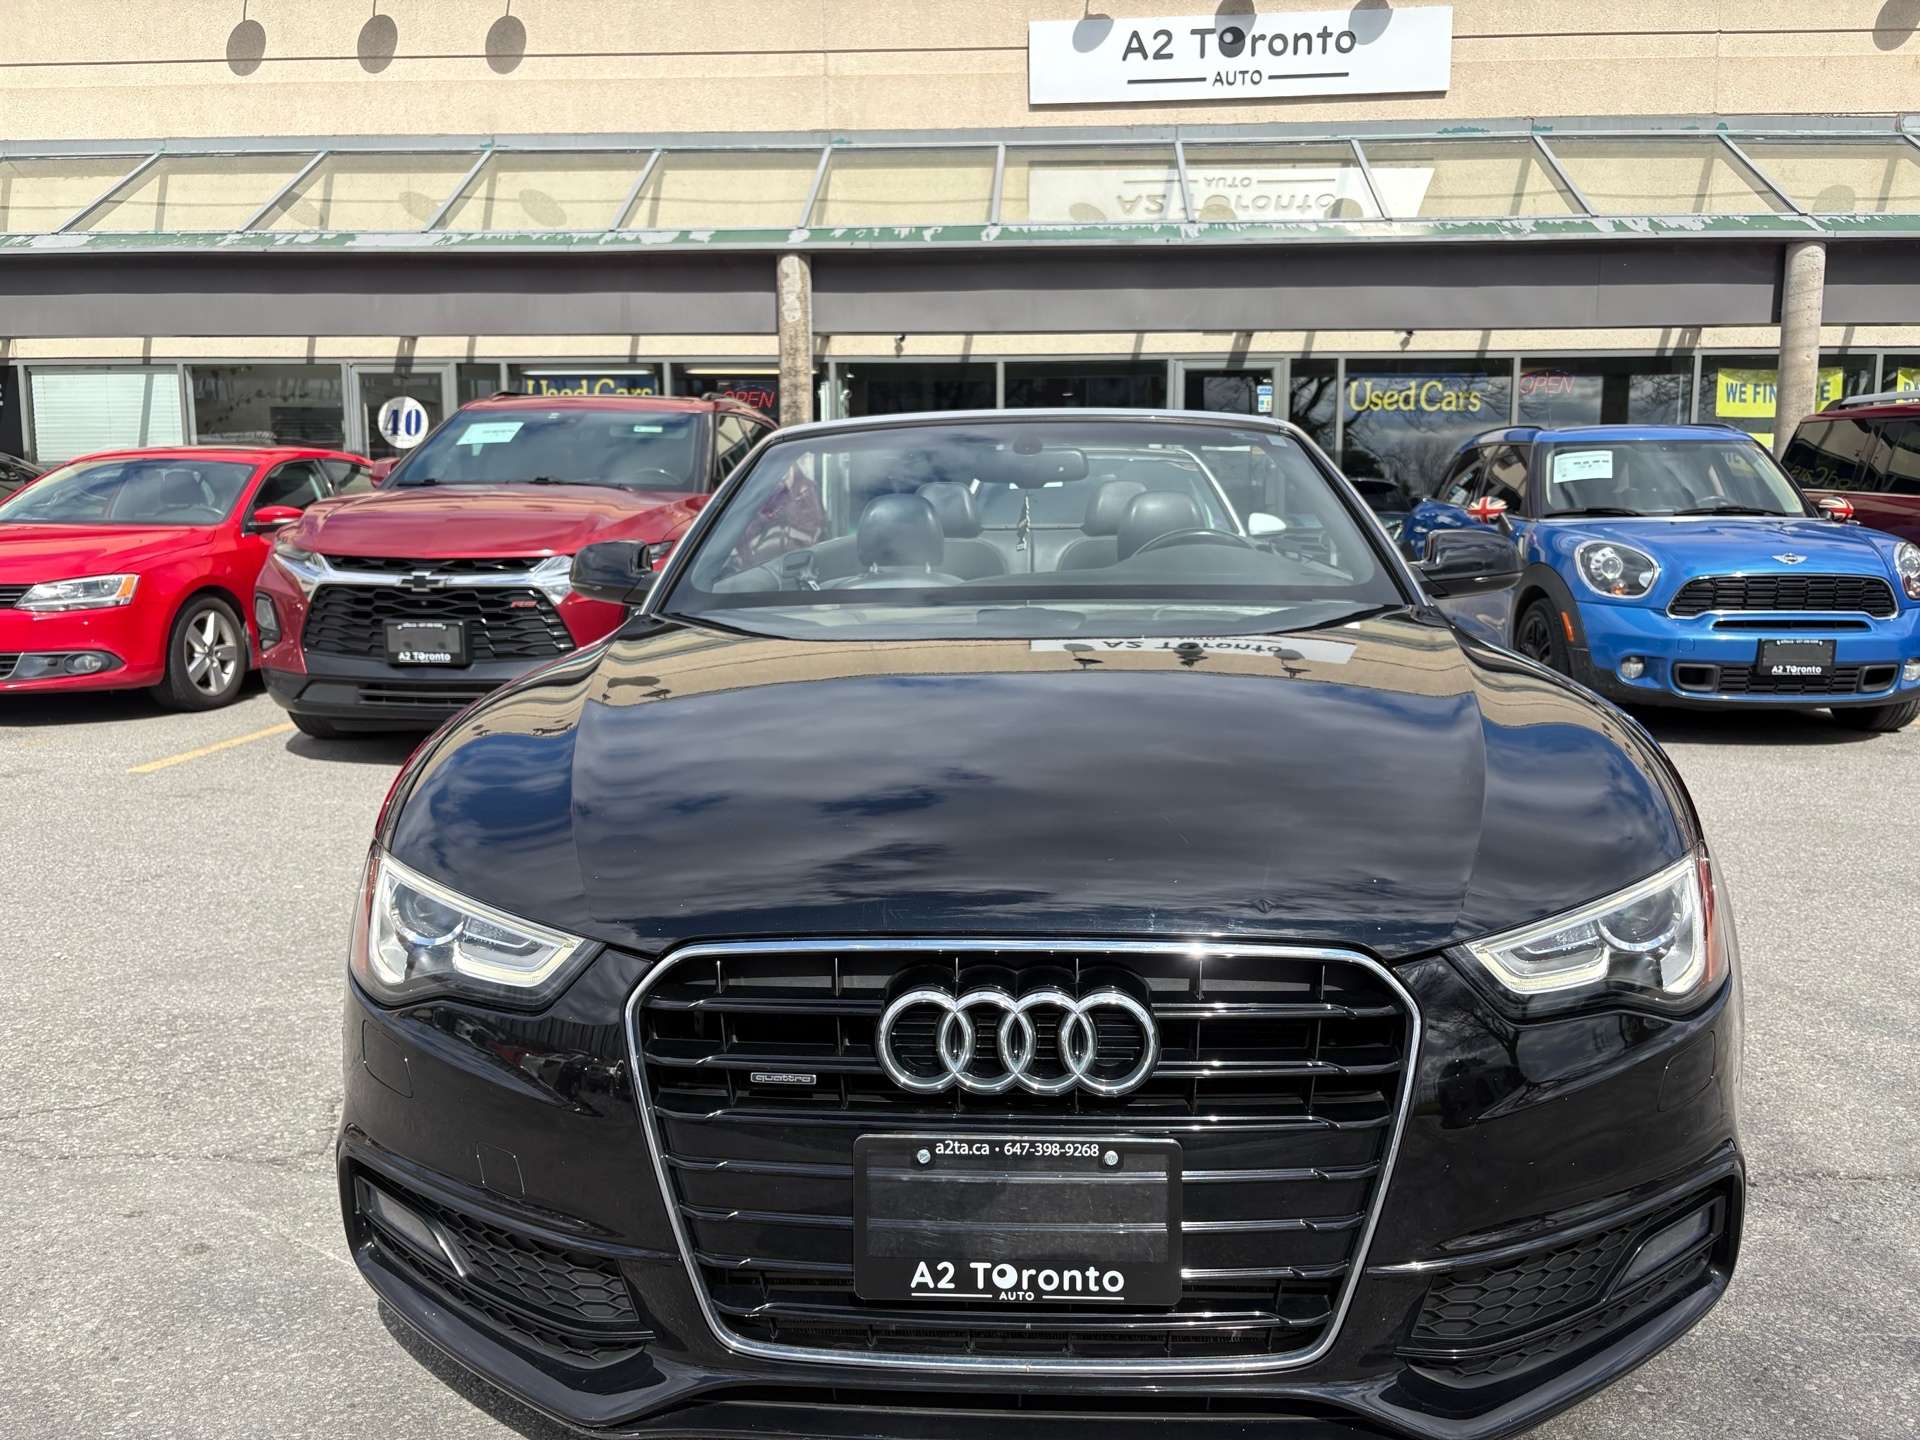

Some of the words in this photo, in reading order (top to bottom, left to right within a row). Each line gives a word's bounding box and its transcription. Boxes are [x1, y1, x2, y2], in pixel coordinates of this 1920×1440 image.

[1122, 29, 1174, 61] A2
[1212, 70, 1263, 86] AUTO
[1519, 375, 1575, 394] OPEN
[1726, 382, 1747, 403] WE
[1350, 380, 1416, 411] Used
[1420, 380, 1482, 412] Cars
[384, 409, 422, 437] 40
[755, 1074, 811, 1083] quattro
[935, 1140, 990, 1155] a2ta.ca
[1004, 1142, 1100, 1157] 647-398-9268
[910, 1261, 956, 1289] A2
[969, 1262, 1125, 1293] Toronto
[999, 1291, 1035, 1301] AUTO
